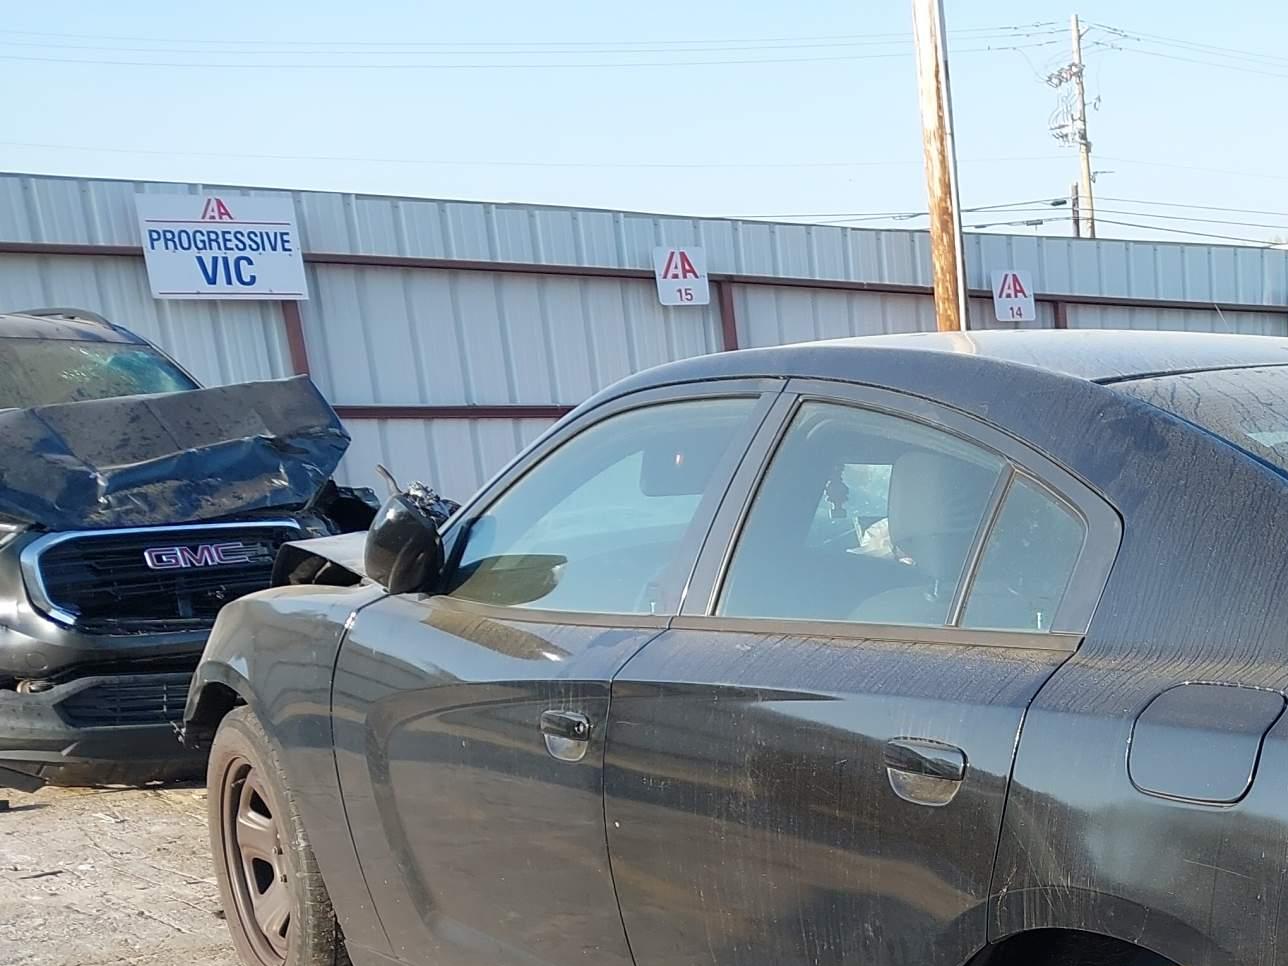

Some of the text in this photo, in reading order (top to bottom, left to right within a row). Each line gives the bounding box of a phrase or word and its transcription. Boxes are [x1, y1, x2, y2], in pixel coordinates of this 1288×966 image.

[148, 229, 292, 252] PROGRESSIVE
[195, 255, 257, 286] VIC
[676, 288, 694, 301] 15
[1009, 306, 1023, 319] 14
[143, 541, 249, 569] GMC
